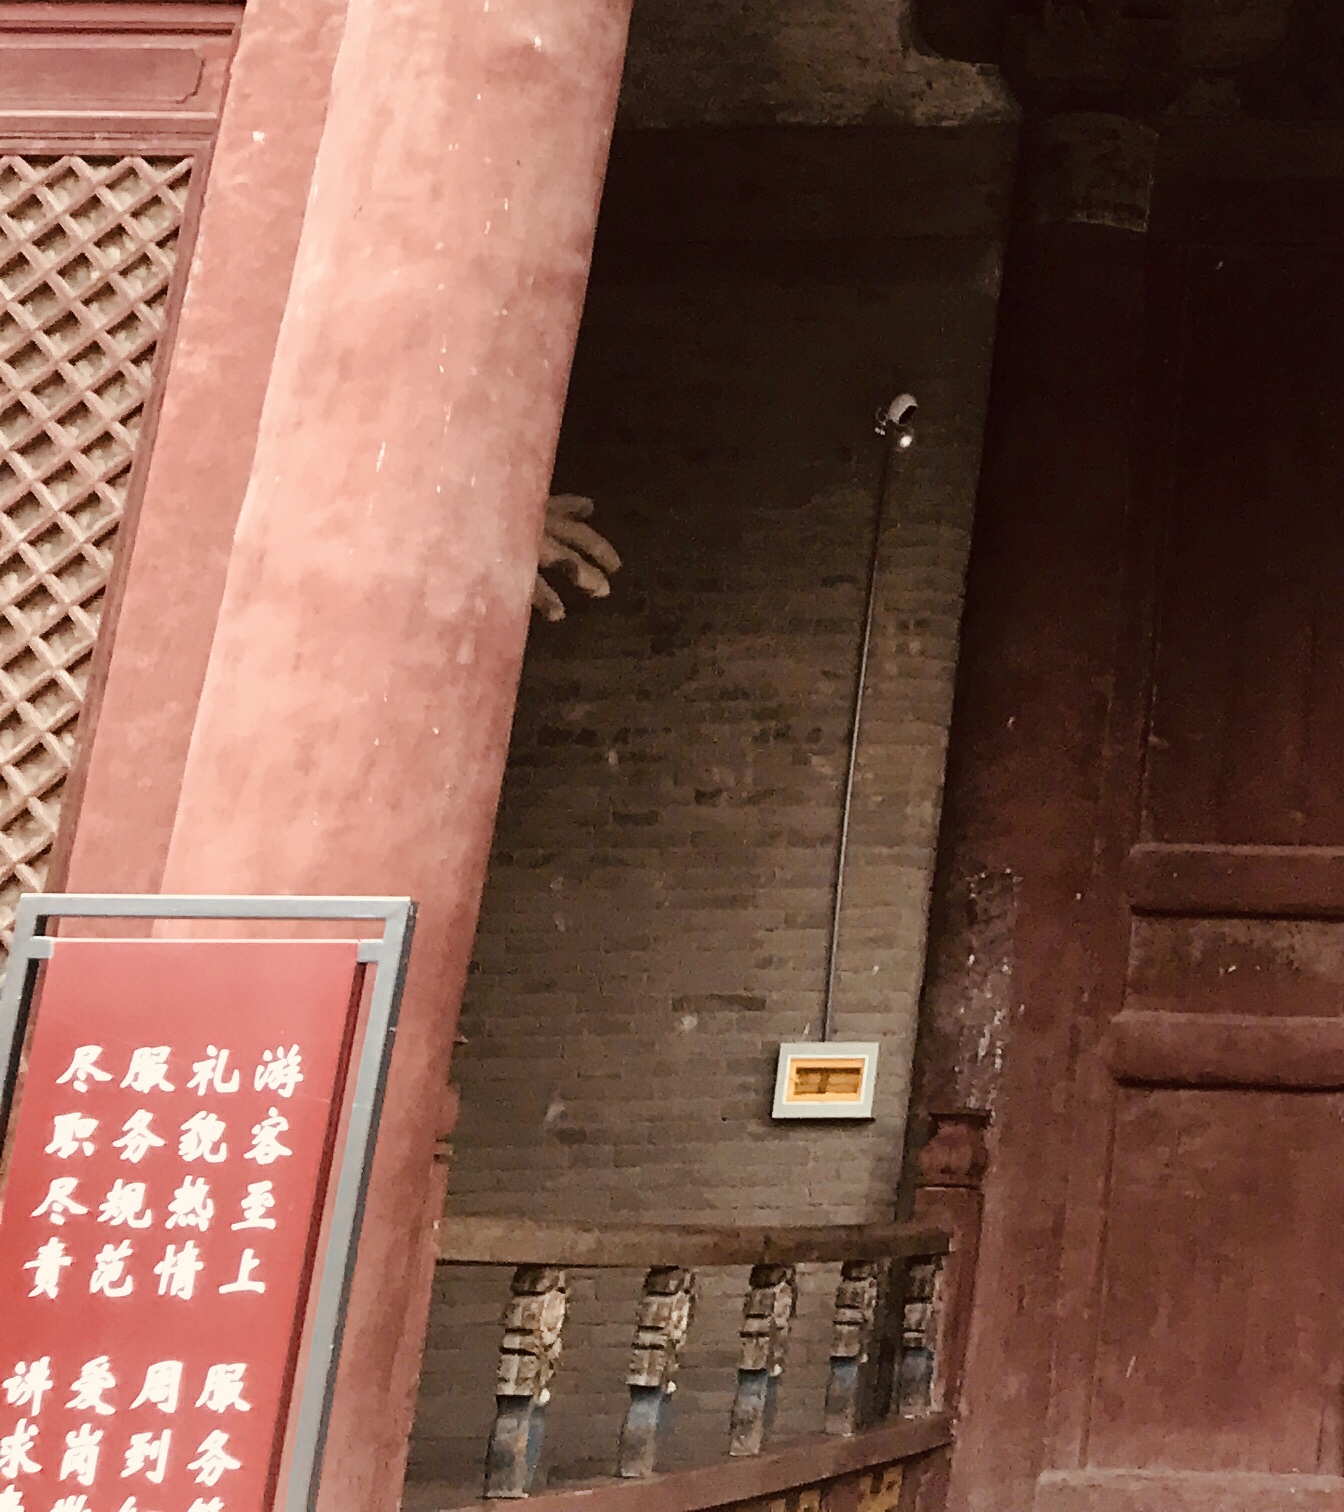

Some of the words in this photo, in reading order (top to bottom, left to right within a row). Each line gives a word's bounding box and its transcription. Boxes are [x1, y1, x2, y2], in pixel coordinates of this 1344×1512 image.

[24, 1045, 112, 1299] 尽职尽责
[88, 1046, 174, 1299] 服务规范
[154, 1045, 239, 1300] 礼貌热情
[218, 1045, 304, 1294] 游客至上
[53, 1356, 116, 1512] 爱岗
[118, 1360, 183, 1512] 周到
[187, 1363, 252, 1512] 服务
